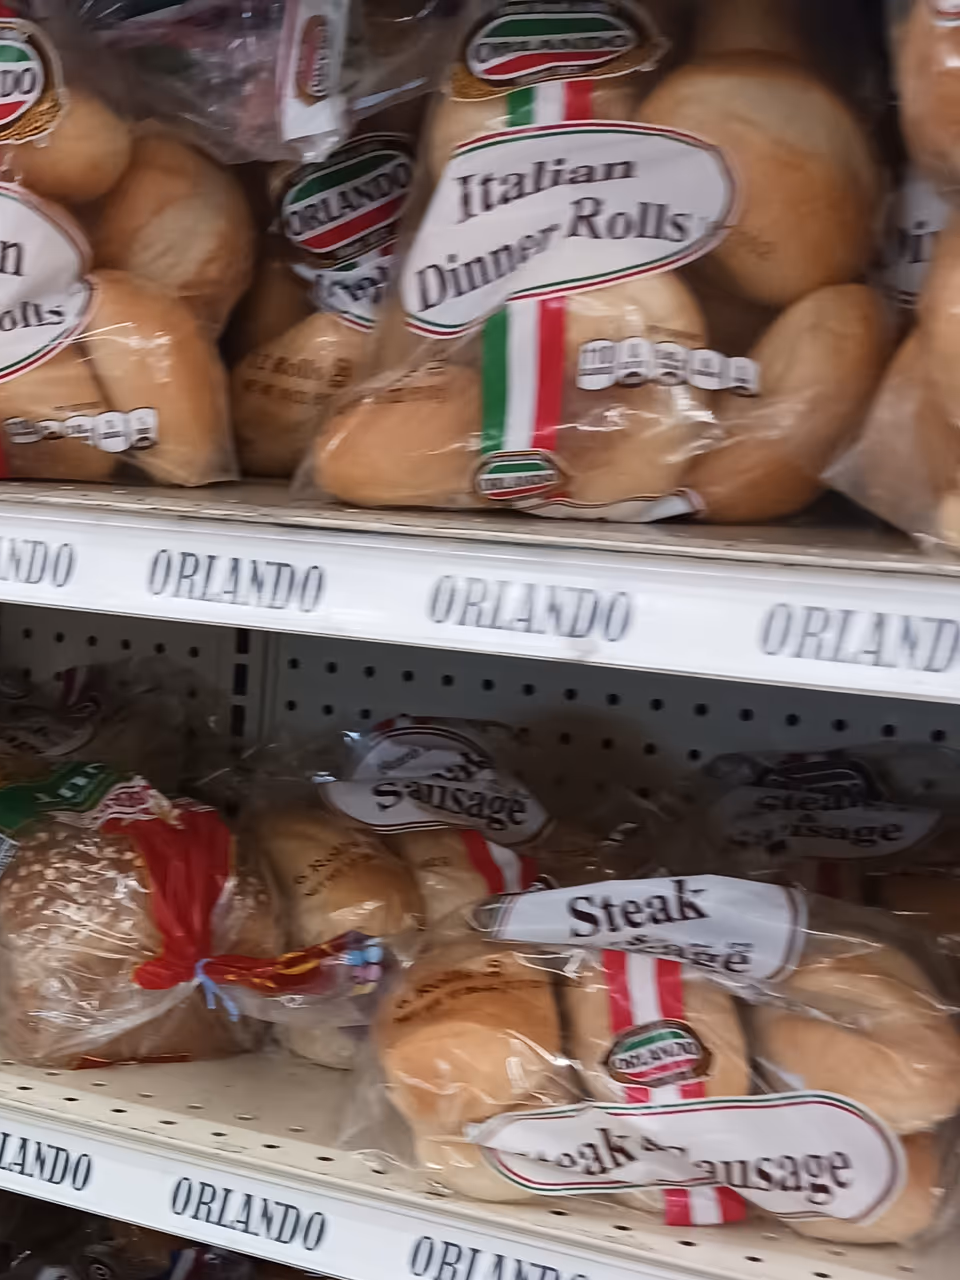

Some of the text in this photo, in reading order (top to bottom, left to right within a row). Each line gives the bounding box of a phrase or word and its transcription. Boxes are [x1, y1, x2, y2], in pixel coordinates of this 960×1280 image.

[289, 162, 412, 240] ORLANDO
[455, 158, 638, 225] Italian
[414, 222, 562, 313] Dinner
[564, 196, 692, 244] Rolls
[146, 548, 326, 614] ORLANDO
[427, 574, 634, 643] ORLANDO
[757, 602, 960, 674] ORLAND
[372, 780, 528, 831] Sausage
[567, 879, 712, 938] Steak
[693, 1146, 854, 1206] ausage
[171, 1176, 326, 1252] ORLANDO
